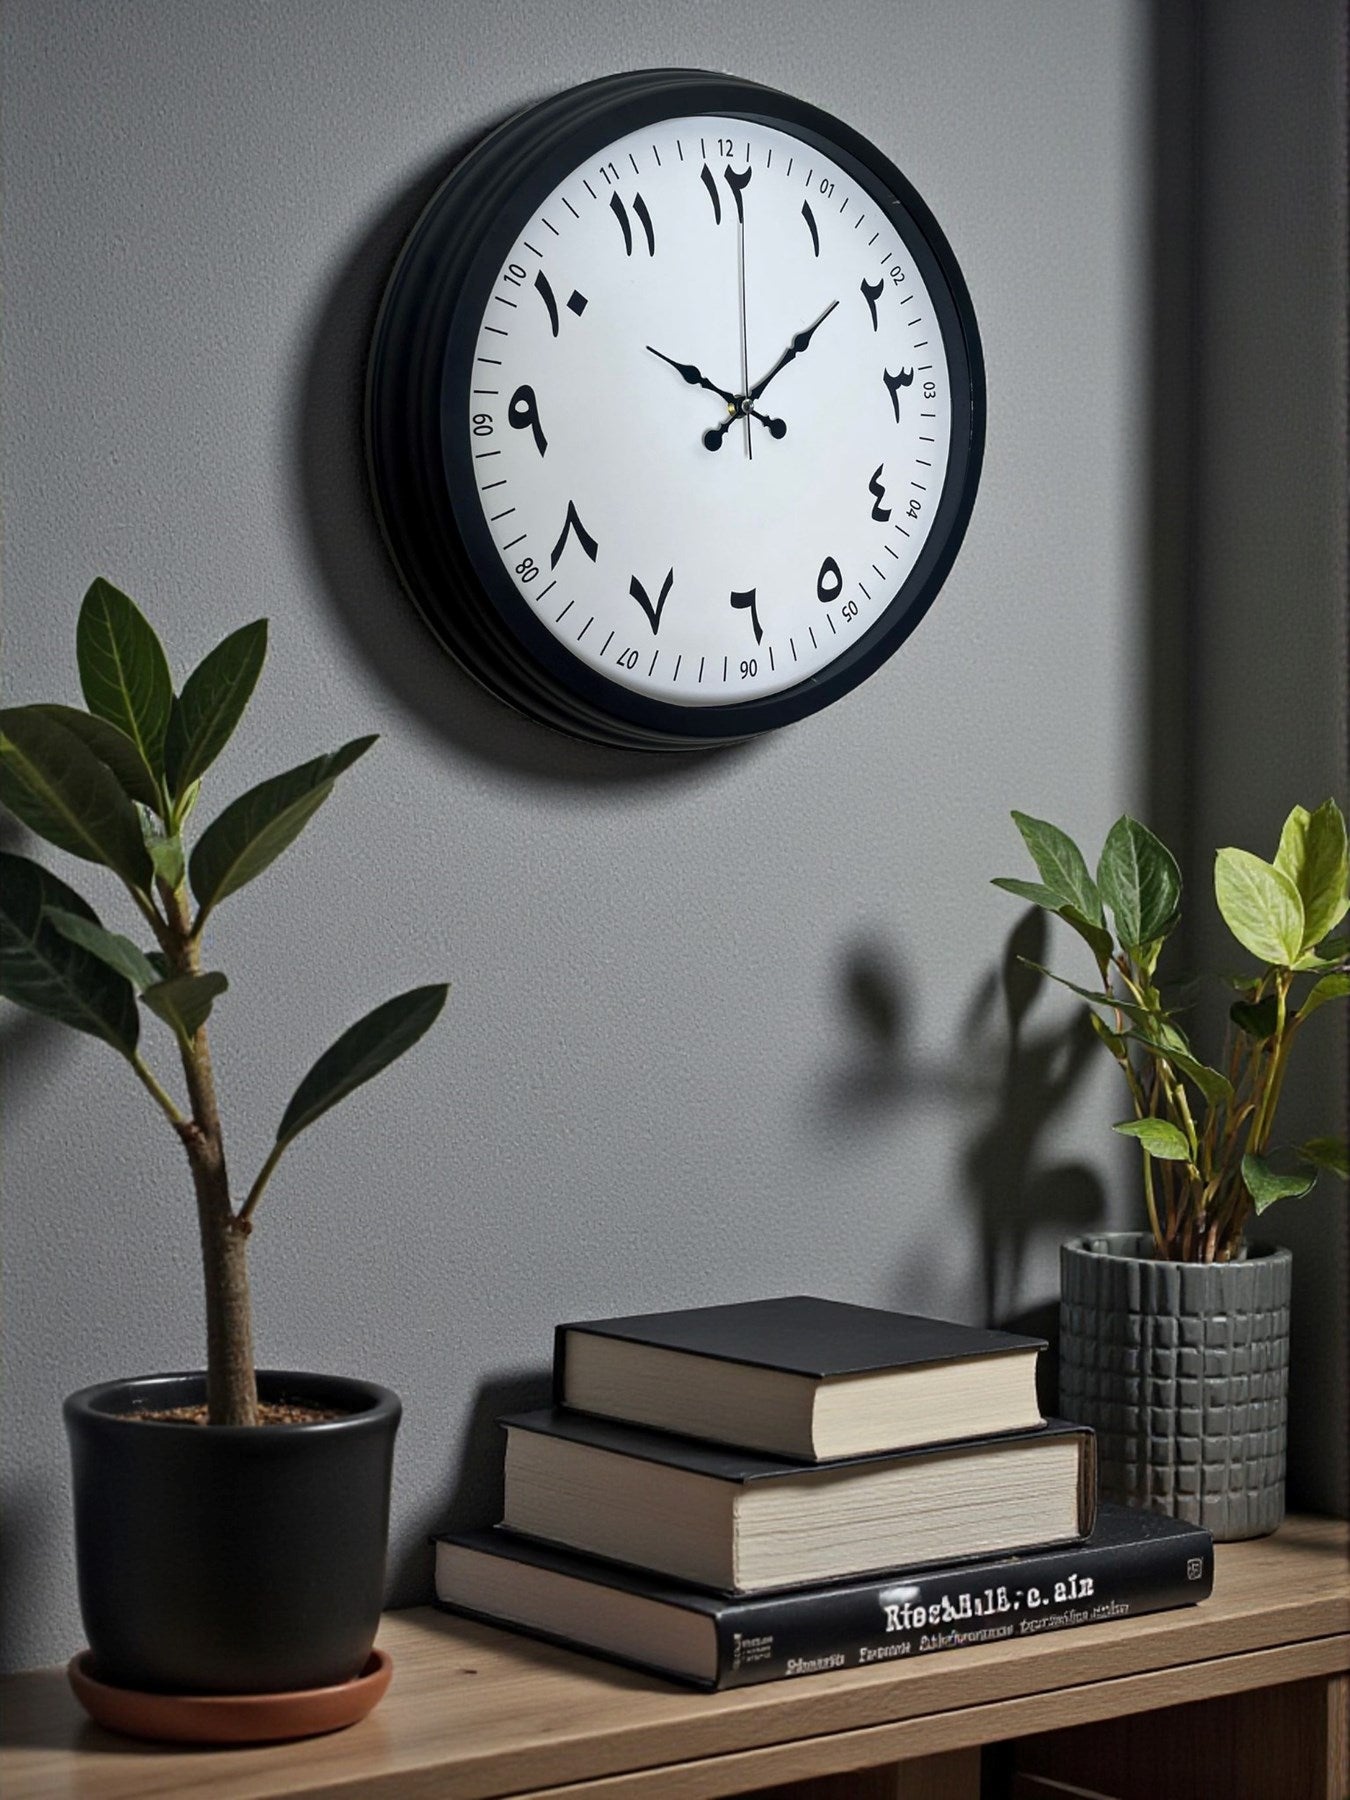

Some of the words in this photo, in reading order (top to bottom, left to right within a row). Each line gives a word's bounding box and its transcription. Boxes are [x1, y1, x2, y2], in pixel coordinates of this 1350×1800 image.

[717, 138, 734, 158] 12
[599, 162, 620, 185] 11
[819, 178, 835, 199] 01
[700, 162, 753, 226] ١٢
[609, 190, 655, 258] ١١
[801, 199, 820, 258] ١
[503, 263, 527, 287] 10
[889, 265, 906, 287] 02
[533, 269, 589, 338] ١٠
[860, 277, 885, 333] ٢
[882, 366, 914, 424] ٣
[922, 381, 937, 399] 03
[471, 413, 494, 437] 09
[507, 384, 549, 459] ٩
[868, 463, 892, 523] ٤
[905, 499, 922, 520] 04
[550, 499, 599, 572] ٨
[514, 557, 540, 584] 08
[816, 556, 843, 603] ٥
[628, 566, 674, 636] ٧
[730, 587, 764, 646] ٦
[841, 600, 859, 623] 05
[615, 647, 639, 670] 07
[739, 658, 758, 680] 06
